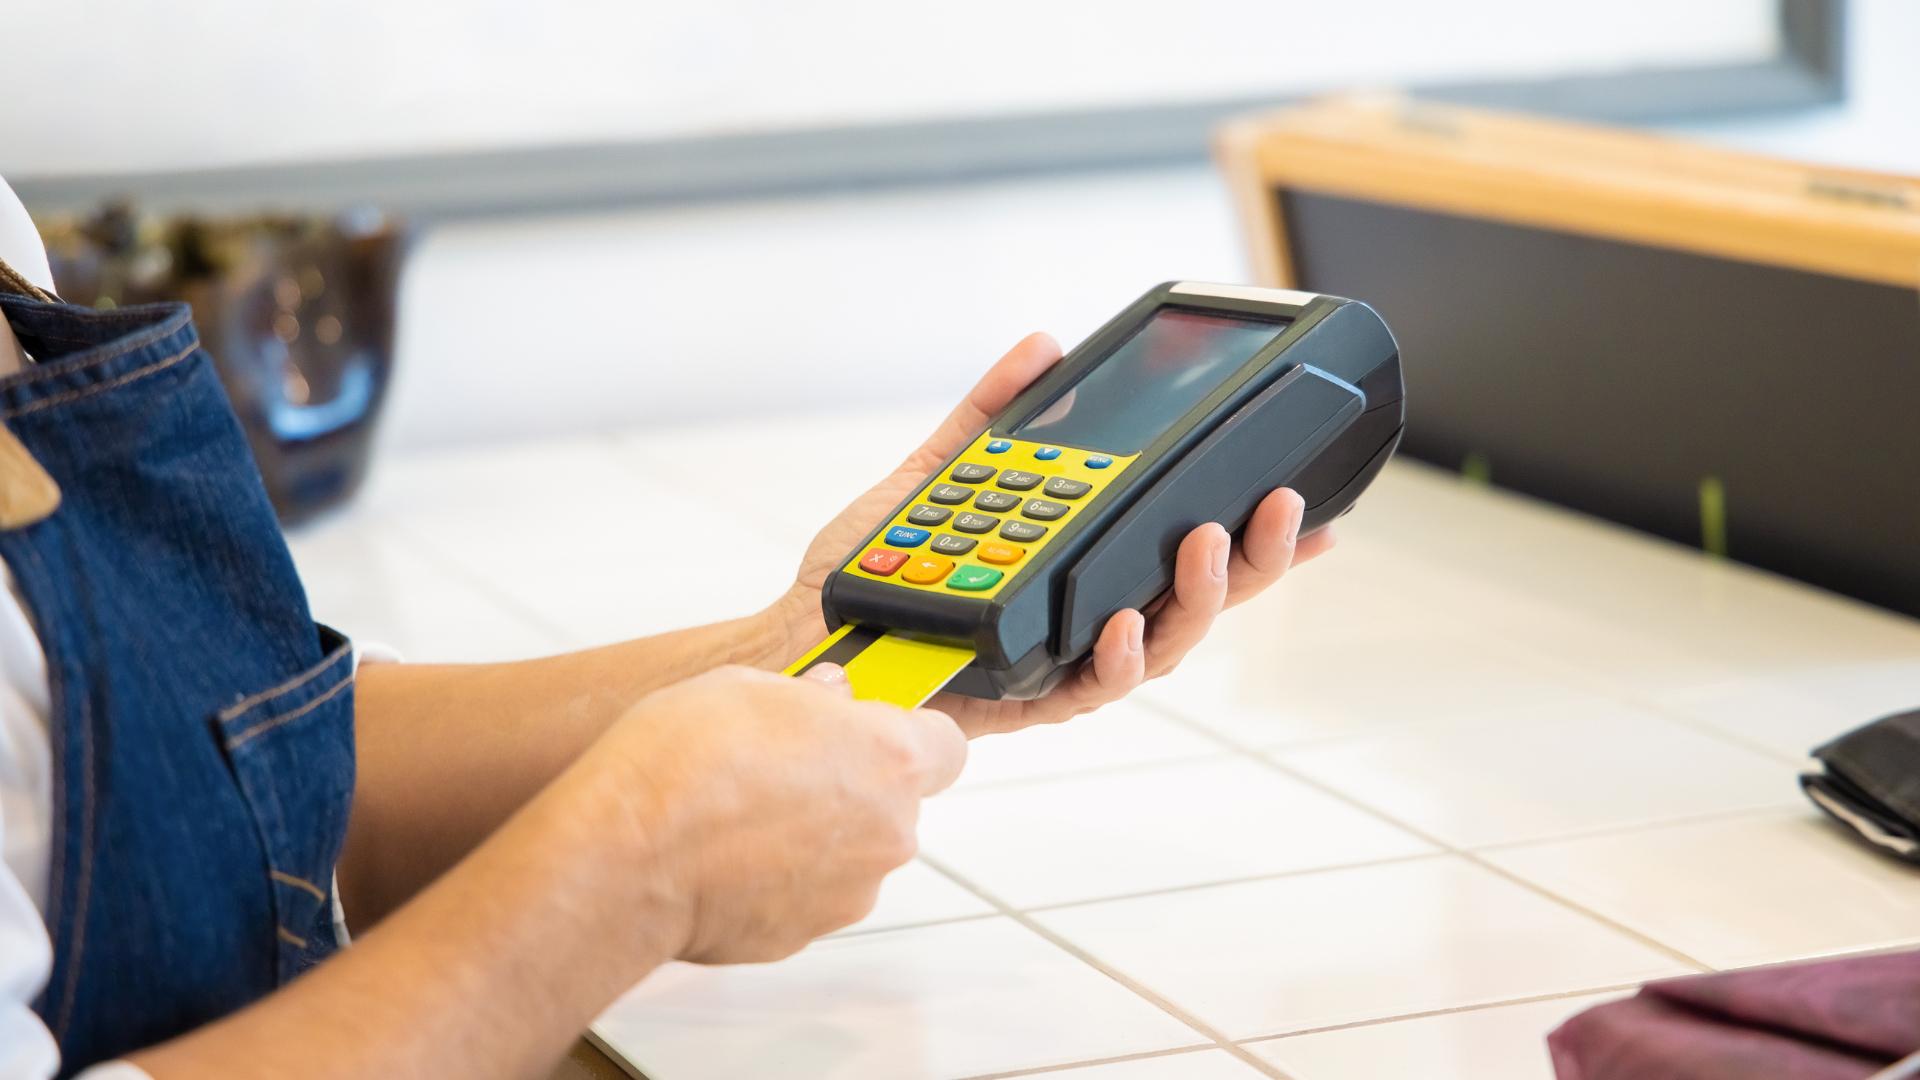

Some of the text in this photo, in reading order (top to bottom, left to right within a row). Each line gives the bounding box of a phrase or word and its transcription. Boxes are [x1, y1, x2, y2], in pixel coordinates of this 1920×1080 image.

[961, 465, 971, 475] 1
[1006, 471, 1019, 481] 2
[1054, 479, 1066, 489] 3
[939, 486, 951, 496] 4
[984, 493, 997, 503] 5
[916, 506, 929, 516] 7
[1030, 501, 1042, 511] 6
[961, 514, 973, 524] 8
[1008, 522, 1020, 533] 9
[894, 529, 918, 539] FUNC
[939, 536, 952, 547] 0
